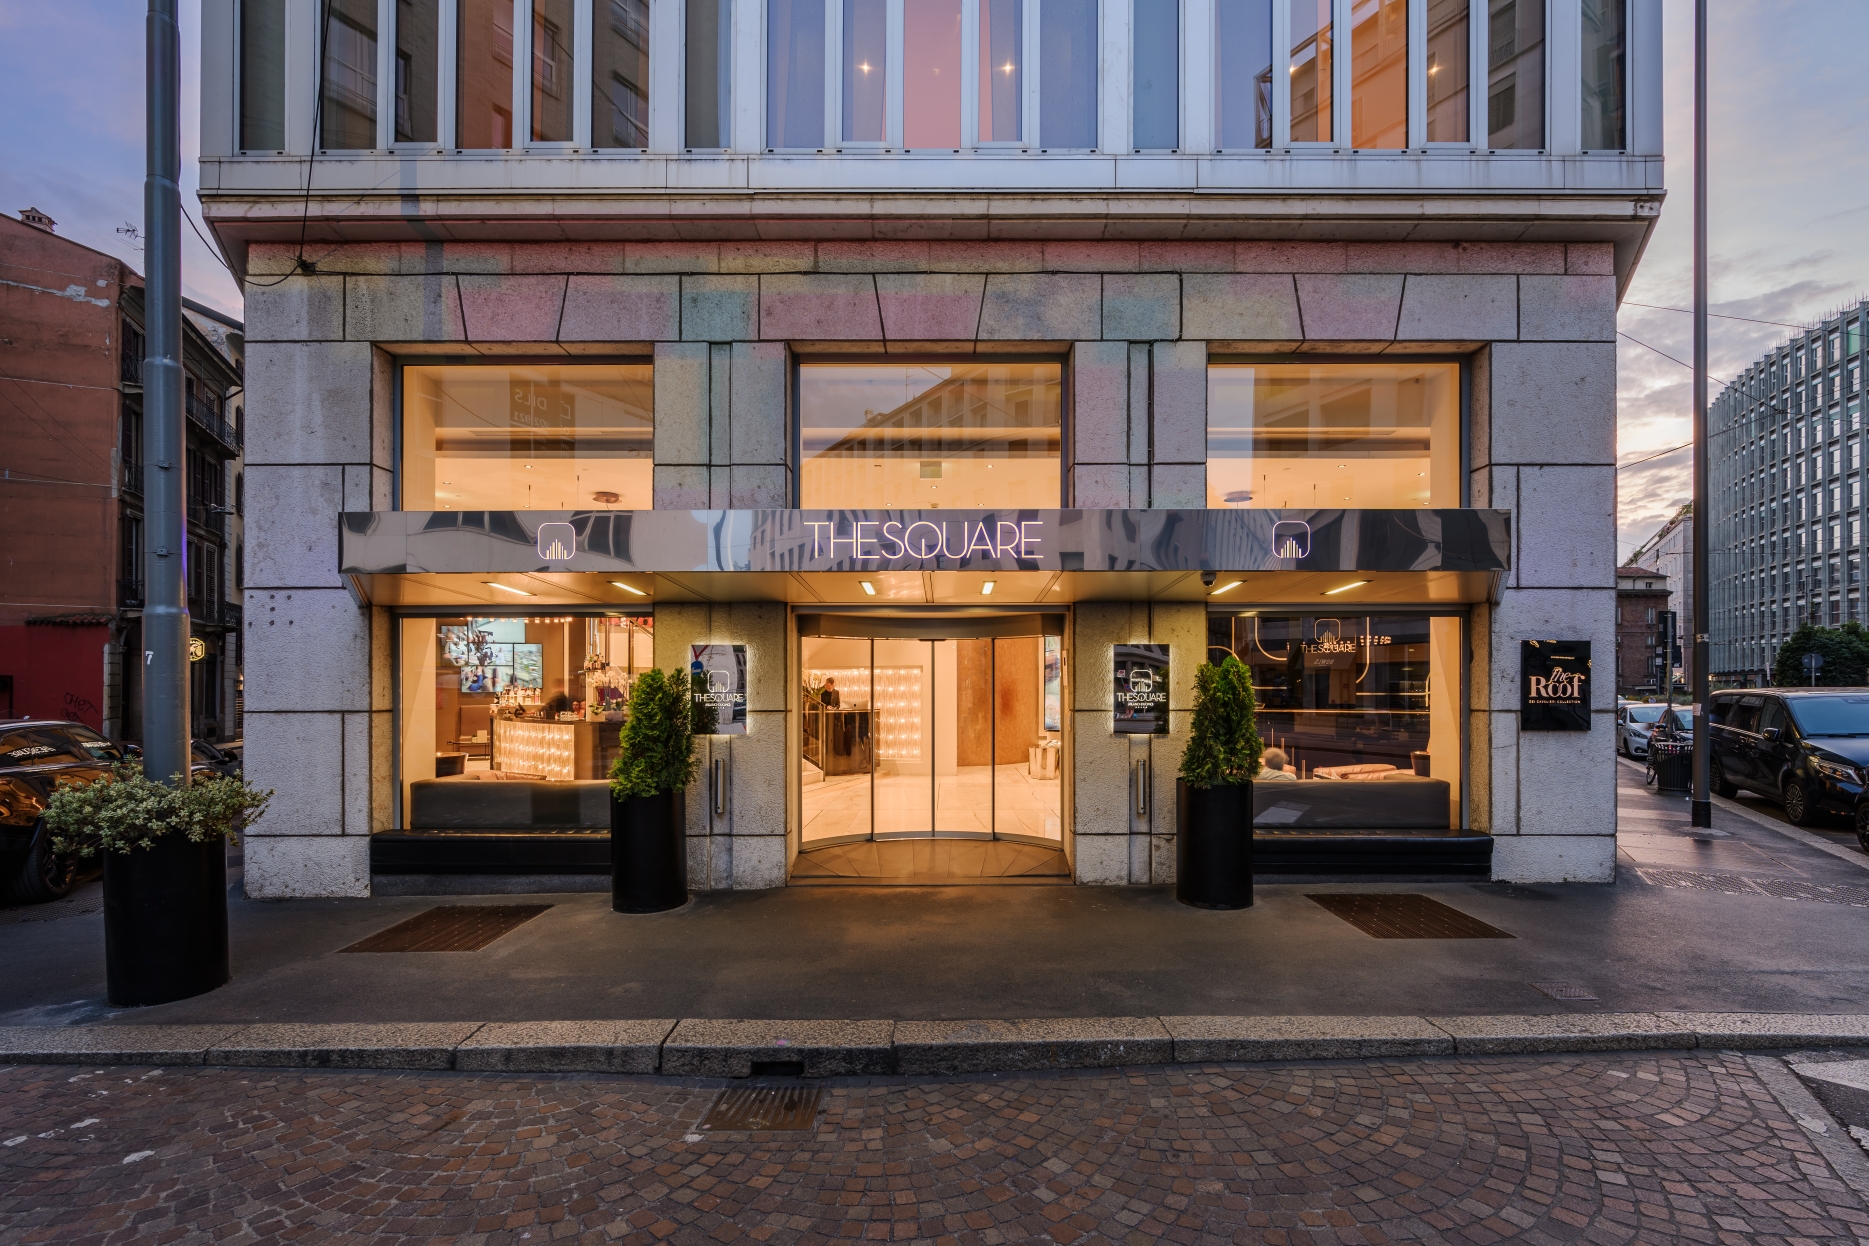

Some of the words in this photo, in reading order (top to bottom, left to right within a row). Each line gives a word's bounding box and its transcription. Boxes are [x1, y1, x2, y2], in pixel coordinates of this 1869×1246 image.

[804, 521, 1044, 559] THESQUARE
[1529, 673, 1586, 698] Roof
[694, 693, 744, 703] THESQUARE
[1117, 692, 1167, 702] THESQUARE
